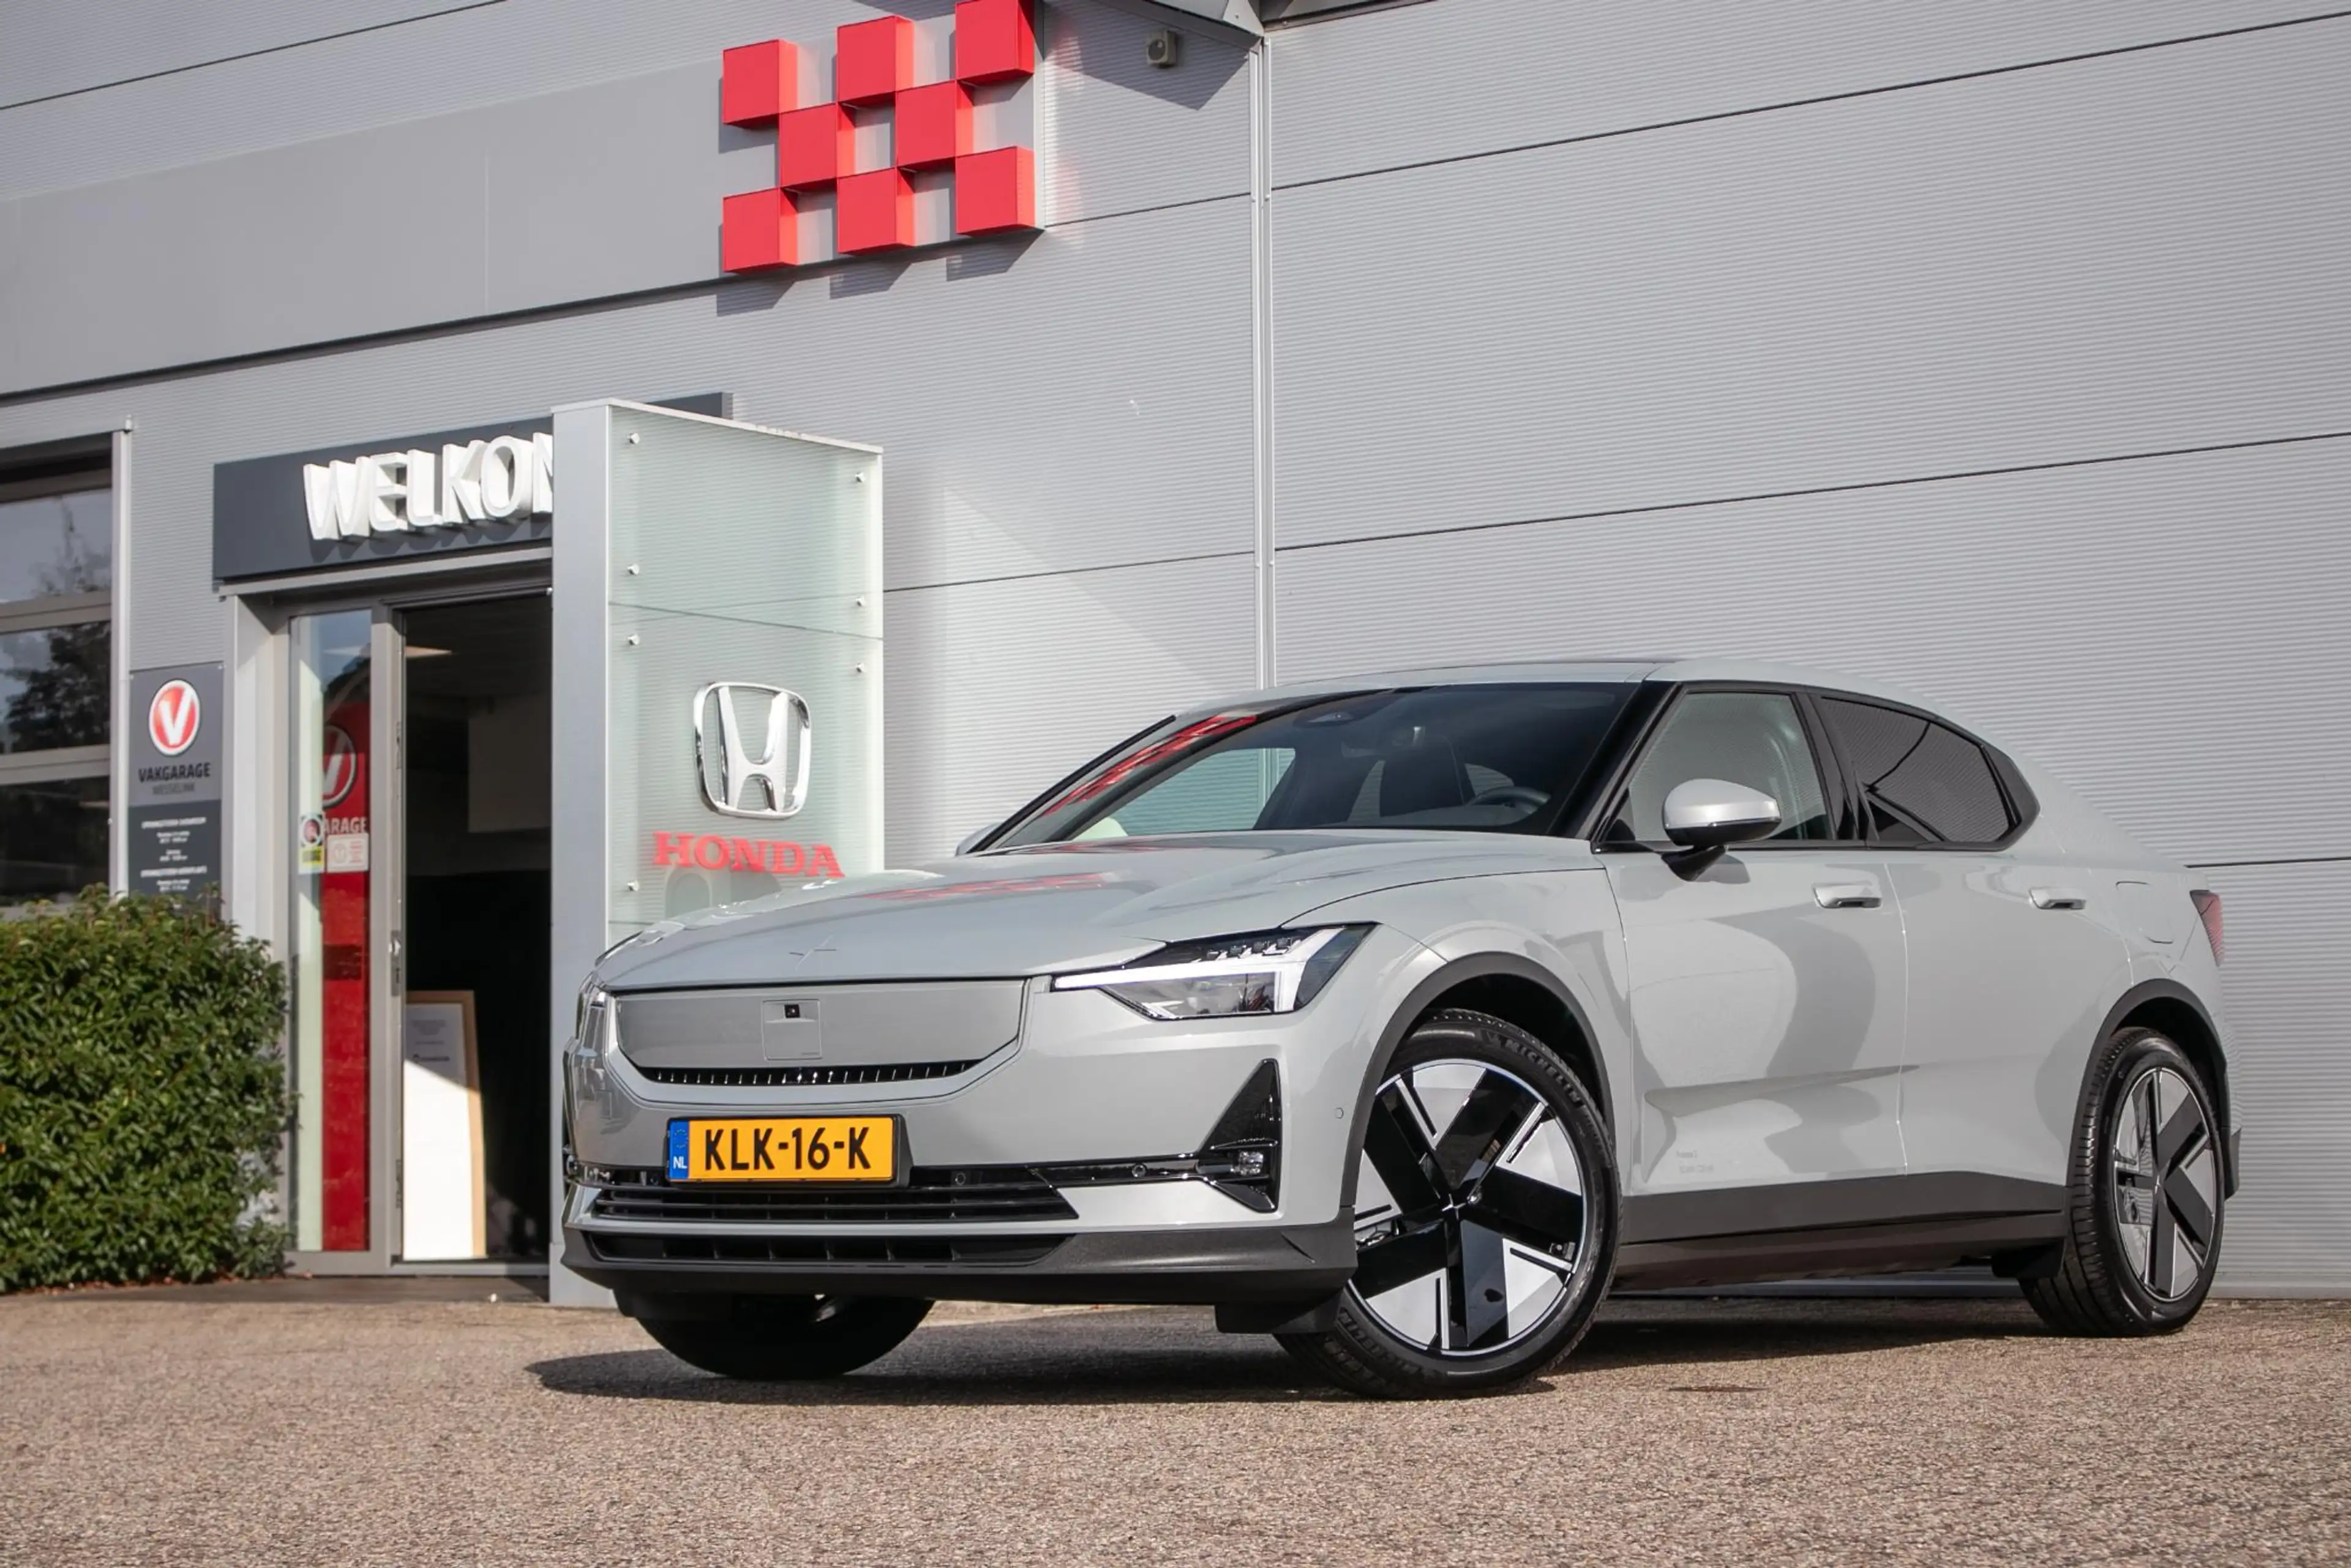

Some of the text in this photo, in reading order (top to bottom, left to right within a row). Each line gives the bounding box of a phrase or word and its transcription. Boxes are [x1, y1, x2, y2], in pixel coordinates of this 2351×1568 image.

[138, 762, 211, 783] VAKGARAGE
[324, 816, 367, 835] ARAGE
[651, 830, 846, 878] HONDA
[1505, 1038, 1581, 1106] MICHELIN
[673, 1127, 872, 1171] NL KLK-16-K
